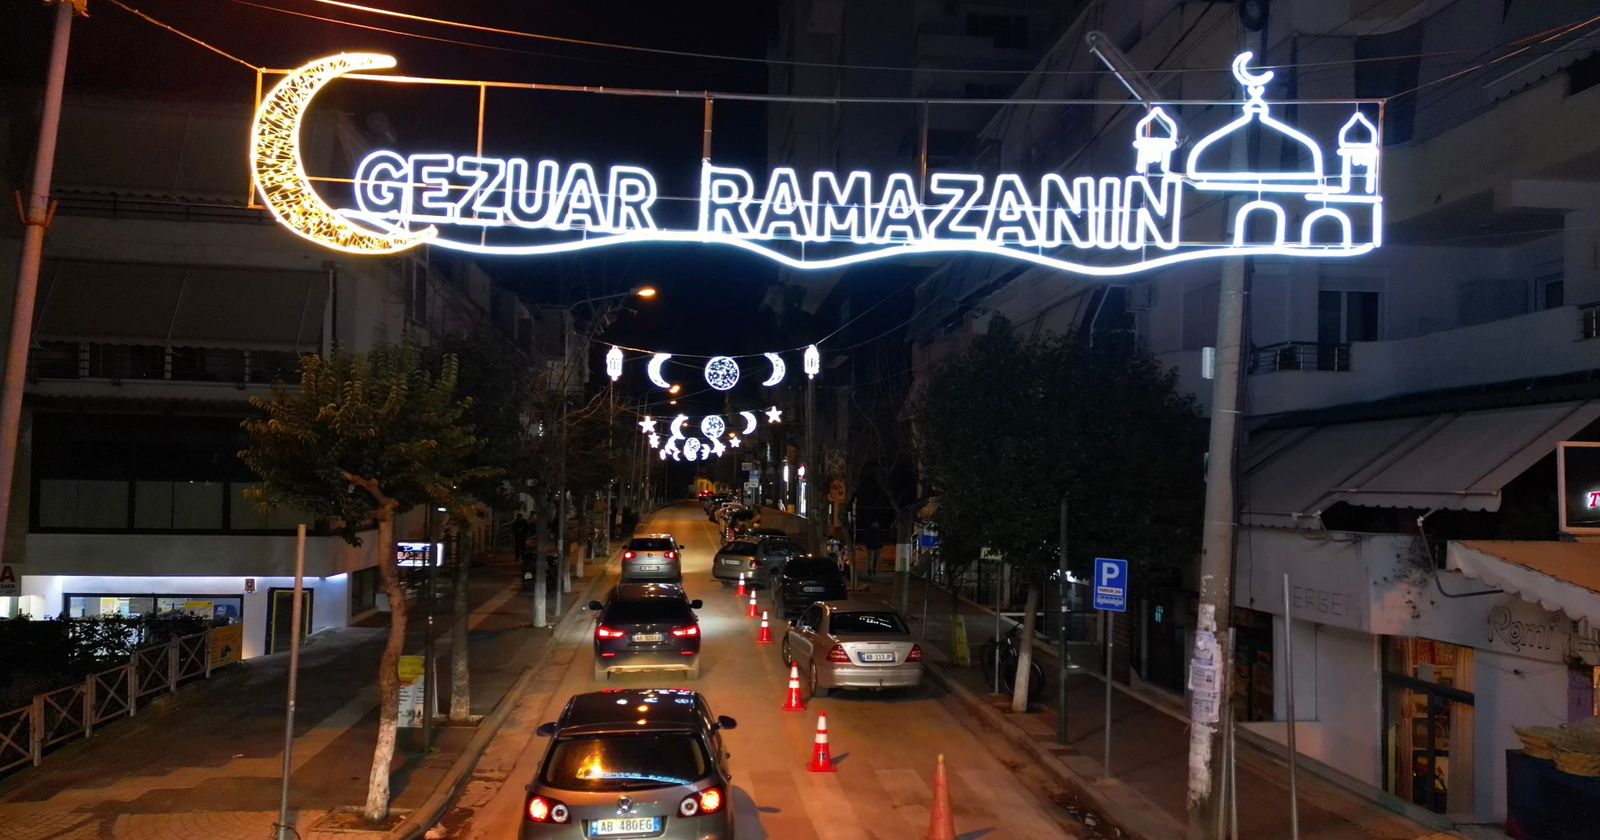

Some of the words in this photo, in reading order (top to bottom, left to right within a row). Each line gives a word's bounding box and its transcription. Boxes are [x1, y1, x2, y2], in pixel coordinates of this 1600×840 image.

[353, 149, 658, 233] GEZUAR
[700, 160, 1183, 251] RAMAZANIN
[1101, 562, 1120, 586] P
[600, 821, 613, 832] AB
[619, 819, 652, 831] 480EG
